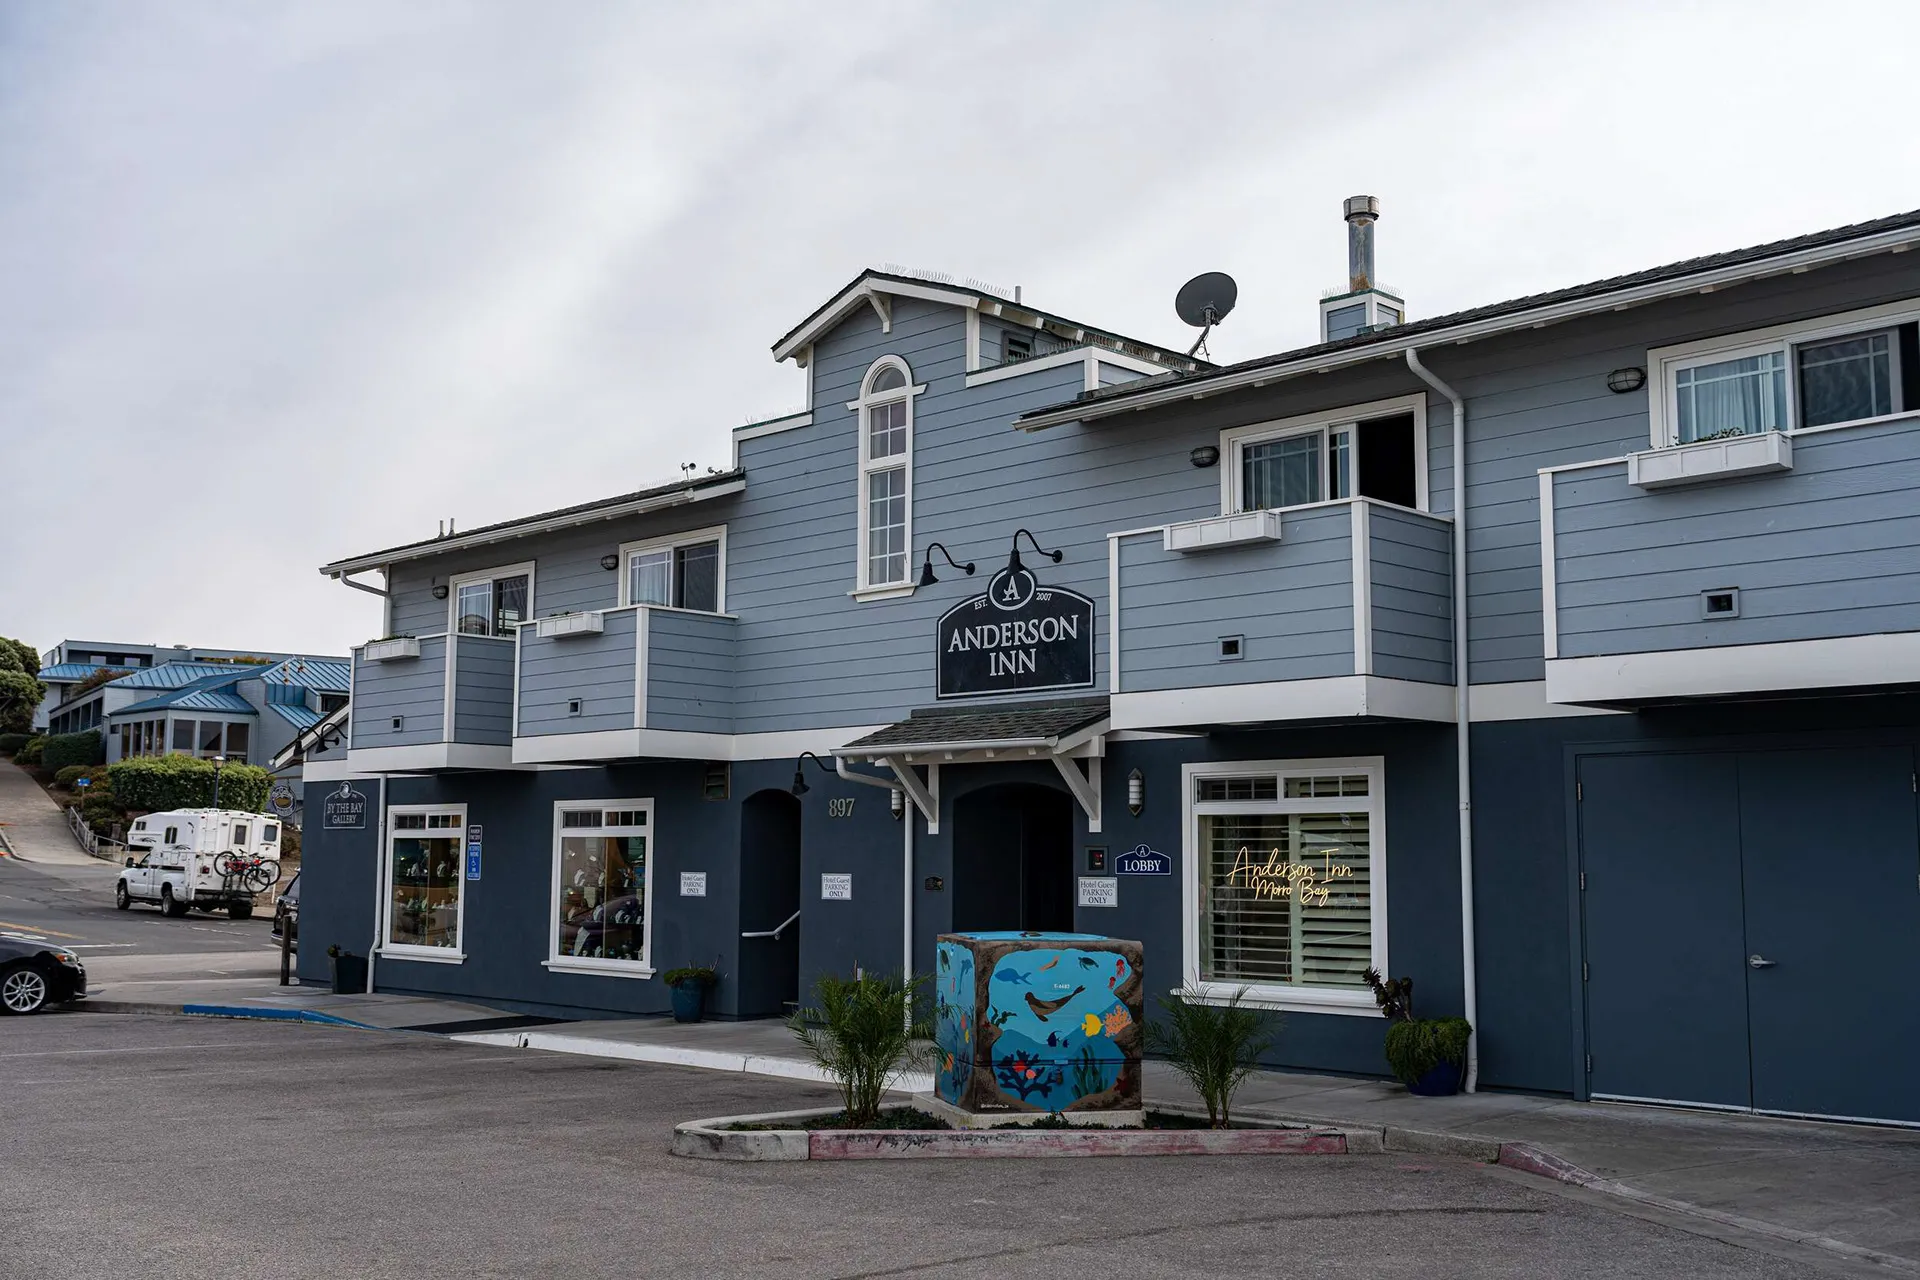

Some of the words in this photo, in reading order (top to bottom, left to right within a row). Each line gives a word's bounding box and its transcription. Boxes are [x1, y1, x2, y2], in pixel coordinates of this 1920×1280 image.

[1002, 575, 1021, 602] A
[974, 599, 988, 610] EST.
[1036, 592, 1052, 601] 2007
[948, 614, 1079, 653] ANDERSON
[989, 648, 1037, 677] INN
[326, 803, 336, 814] BY
[336, 802, 350, 814] THE
[350, 802, 364, 813] BAY
[829, 797, 856, 818] 897
[332, 814, 357, 824] GALLERY
[1124, 859, 1162, 872] LOBBY
[1226, 846, 1316, 888] Anderson
[1320, 848, 1353, 884] Inn
[1080, 880, 1097, 889] Hotel
[1097, 880, 1115, 889] Guest
[1082, 889, 1113, 897] PARKING
[1250, 875, 1292, 901] Morro
[1297, 876, 1331, 907] Bay
[1088, 896, 1107, 904] ONLY
